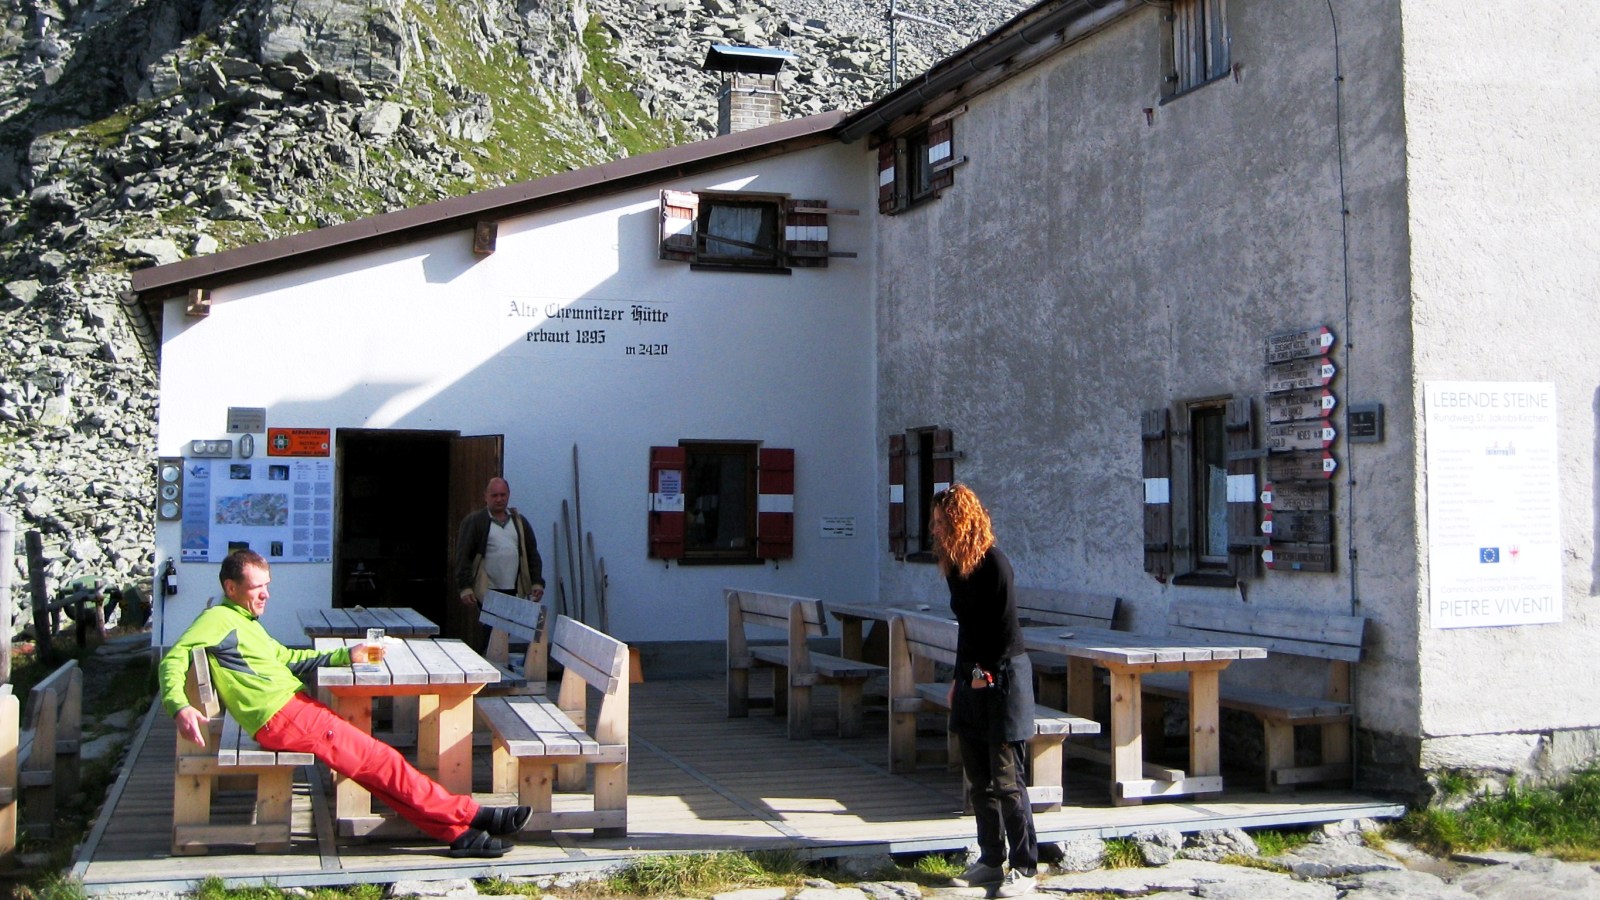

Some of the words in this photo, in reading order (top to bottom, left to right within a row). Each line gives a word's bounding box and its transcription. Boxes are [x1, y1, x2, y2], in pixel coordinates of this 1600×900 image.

[507, 300, 538, 317] Alte
[544, 302, 625, 322] Chemnitzer
[631, 304, 669, 325] Hütte
[526, 328, 570, 343] erbaut
[576, 329, 606, 344] 1895
[625, 345, 636, 355] m
[638, 344, 669, 355] 2420
[1433, 392, 1499, 408] LEBENDE
[1503, 392, 1549, 408] STEINE
[1433, 413, 1474, 424] Rundweg
[1440, 599, 1489, 617] PIETRE
[1495, 596, 1553, 614] VIVENTI
